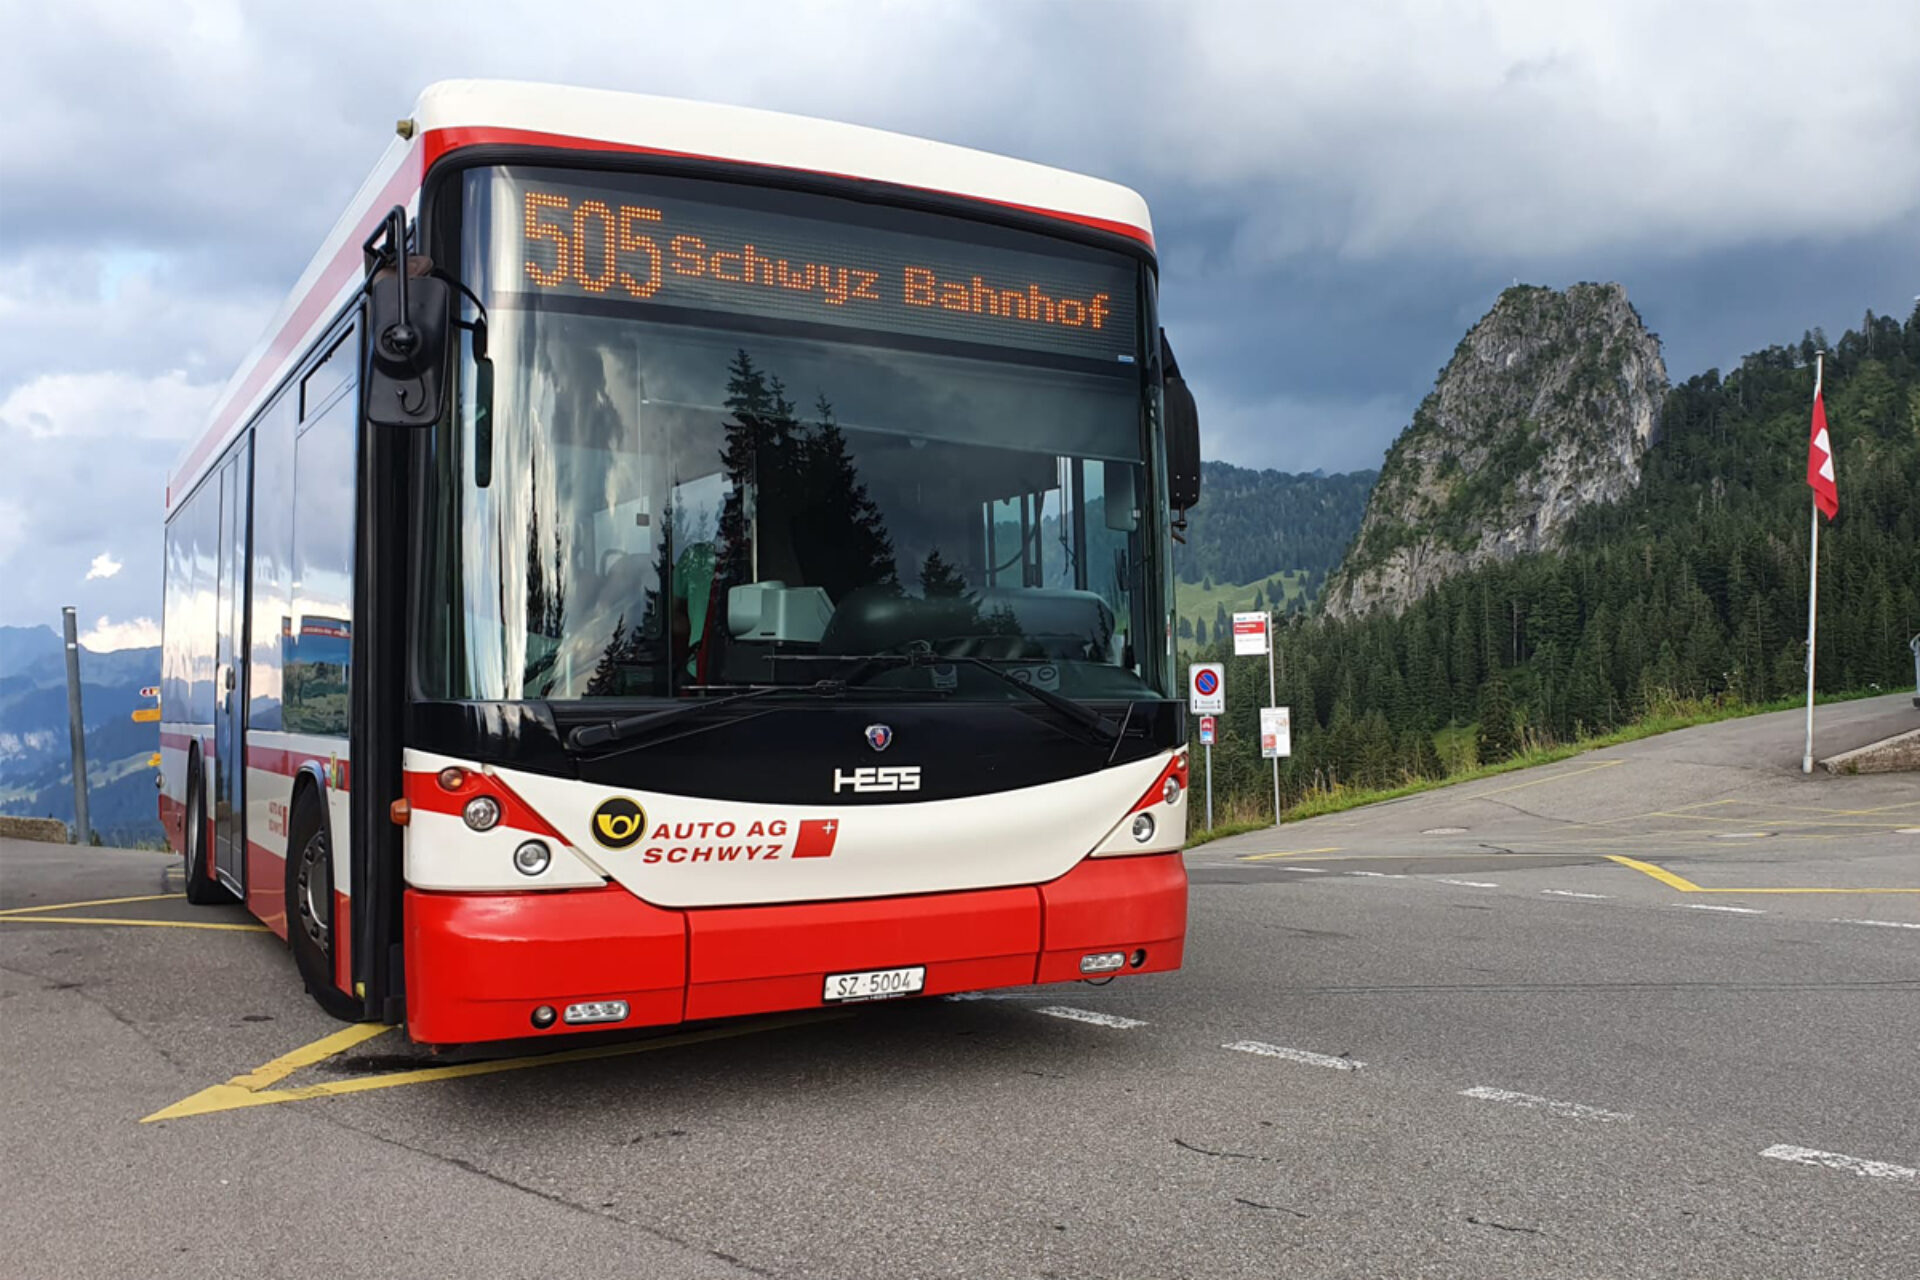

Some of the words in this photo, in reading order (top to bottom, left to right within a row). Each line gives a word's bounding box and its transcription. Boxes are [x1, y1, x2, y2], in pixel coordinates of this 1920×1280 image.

[524, 191, 662, 298] 505
[670, 235, 879, 303] Schwyz
[904, 266, 1110, 329] Bahnhof
[833, 766, 921, 793] HESS
[651, 820, 737, 841] AUTO
[746, 819, 788, 837] AG
[642, 843, 784, 865] SCHWYZ
[836, 975, 859, 996] SZ
[869, 971, 911, 993] 5004
